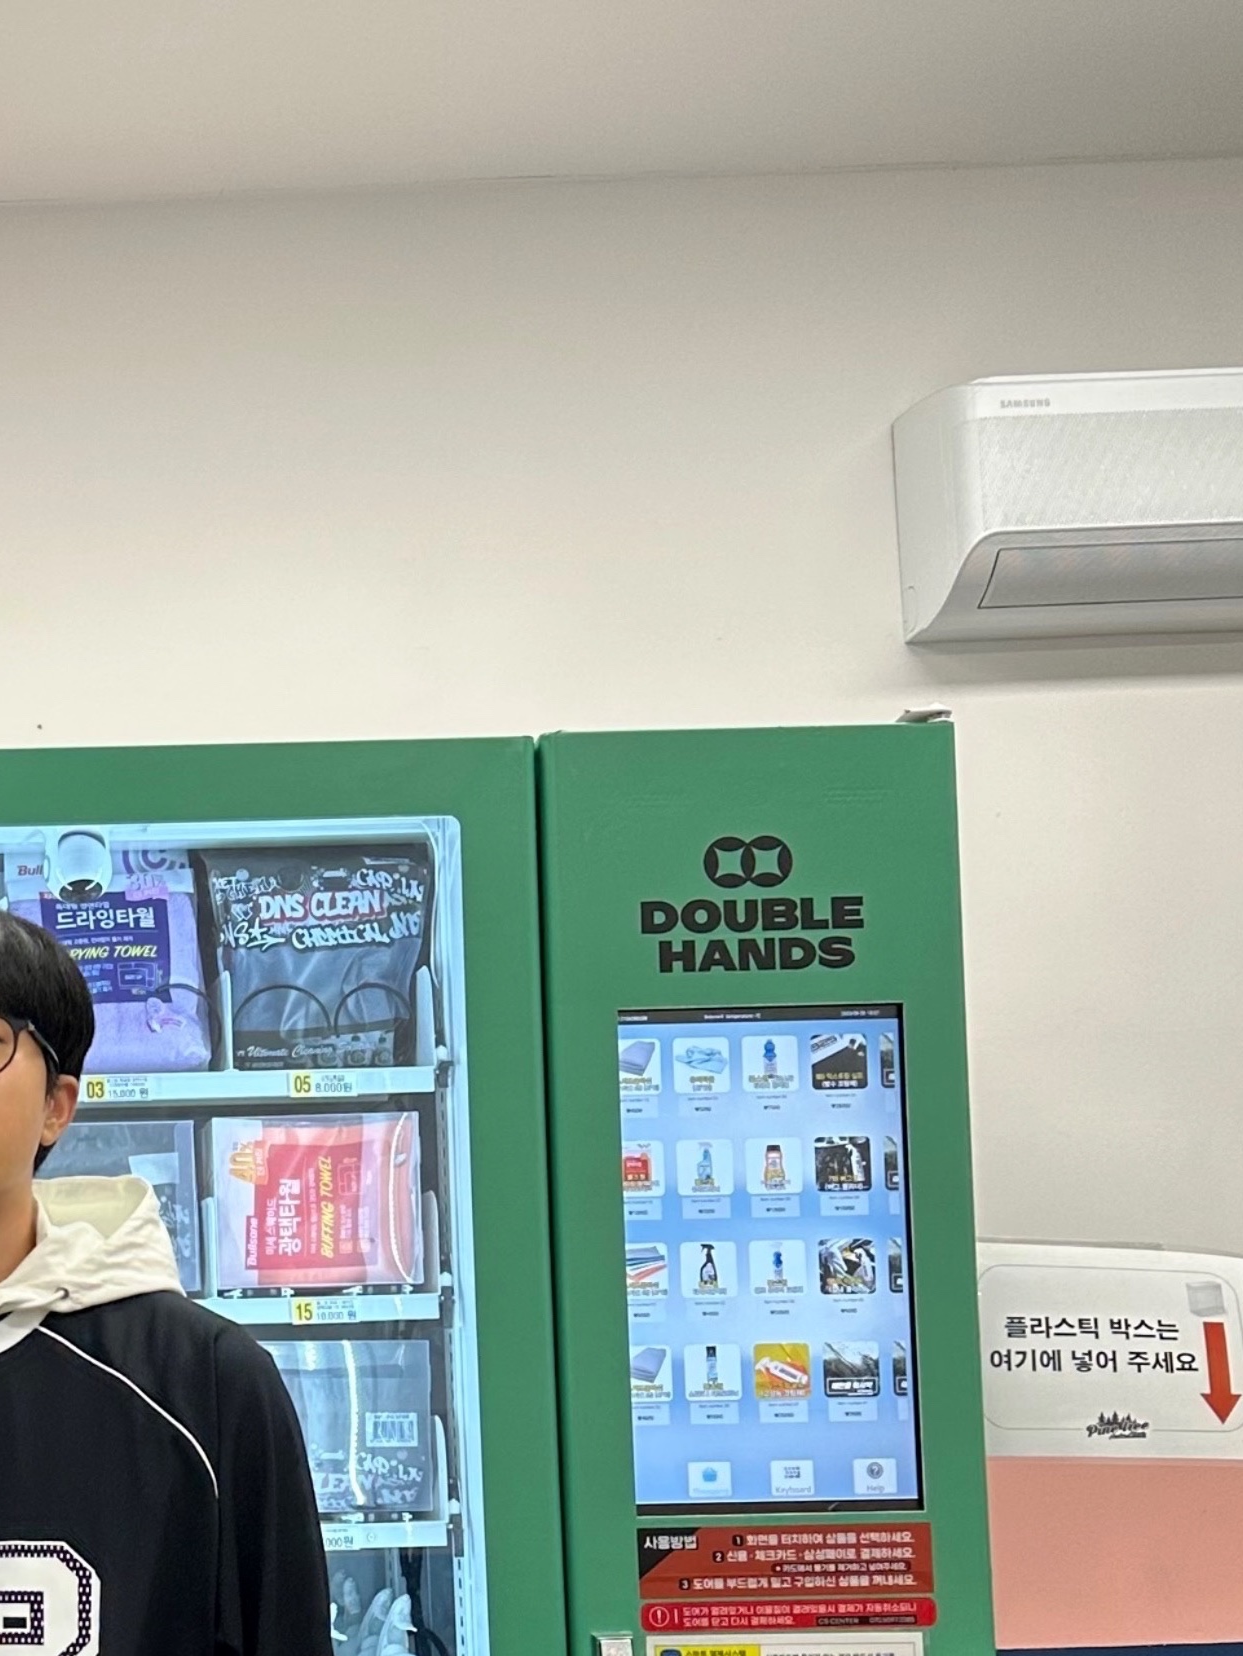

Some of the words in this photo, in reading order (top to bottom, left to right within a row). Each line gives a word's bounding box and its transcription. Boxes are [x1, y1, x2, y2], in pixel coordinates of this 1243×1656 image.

[999, 398, 1051, 409] SAMSUNG
[259, 894, 304, 920] DNS
[310, 891, 381, 918] CLEAN
[640, 896, 864, 934] DOUBLE
[55, 907, 156, 930] 드라잉타월
[113, 945, 158, 958] TOWEL
[658, 936, 855, 973] HANDS
[86, 1081, 105, 1099] 03
[293, 1075, 312, 1093] 05
[319, 1155, 332, 1201] TOWEL
[278, 1179, 301, 1257] 광택타월
[247, 1218, 258, 1268] Bullsone
[320, 1205, 335, 1260] BUFFING
[295, 1303, 313, 1321] 15
[1004, 1316, 1100, 1340] 플라스틱
[1109, 1318, 1180, 1341] 박스는
[990, 1349, 1062, 1372] 여기에
[1071, 1350, 1118, 1373] 넣어
[1127, 1351, 1200, 1373] 주세요
[775, 1485, 812, 1495] Keyboard
[866, 1484, 885, 1493] Help
[644, 1535, 698, 1550] 사용방법
